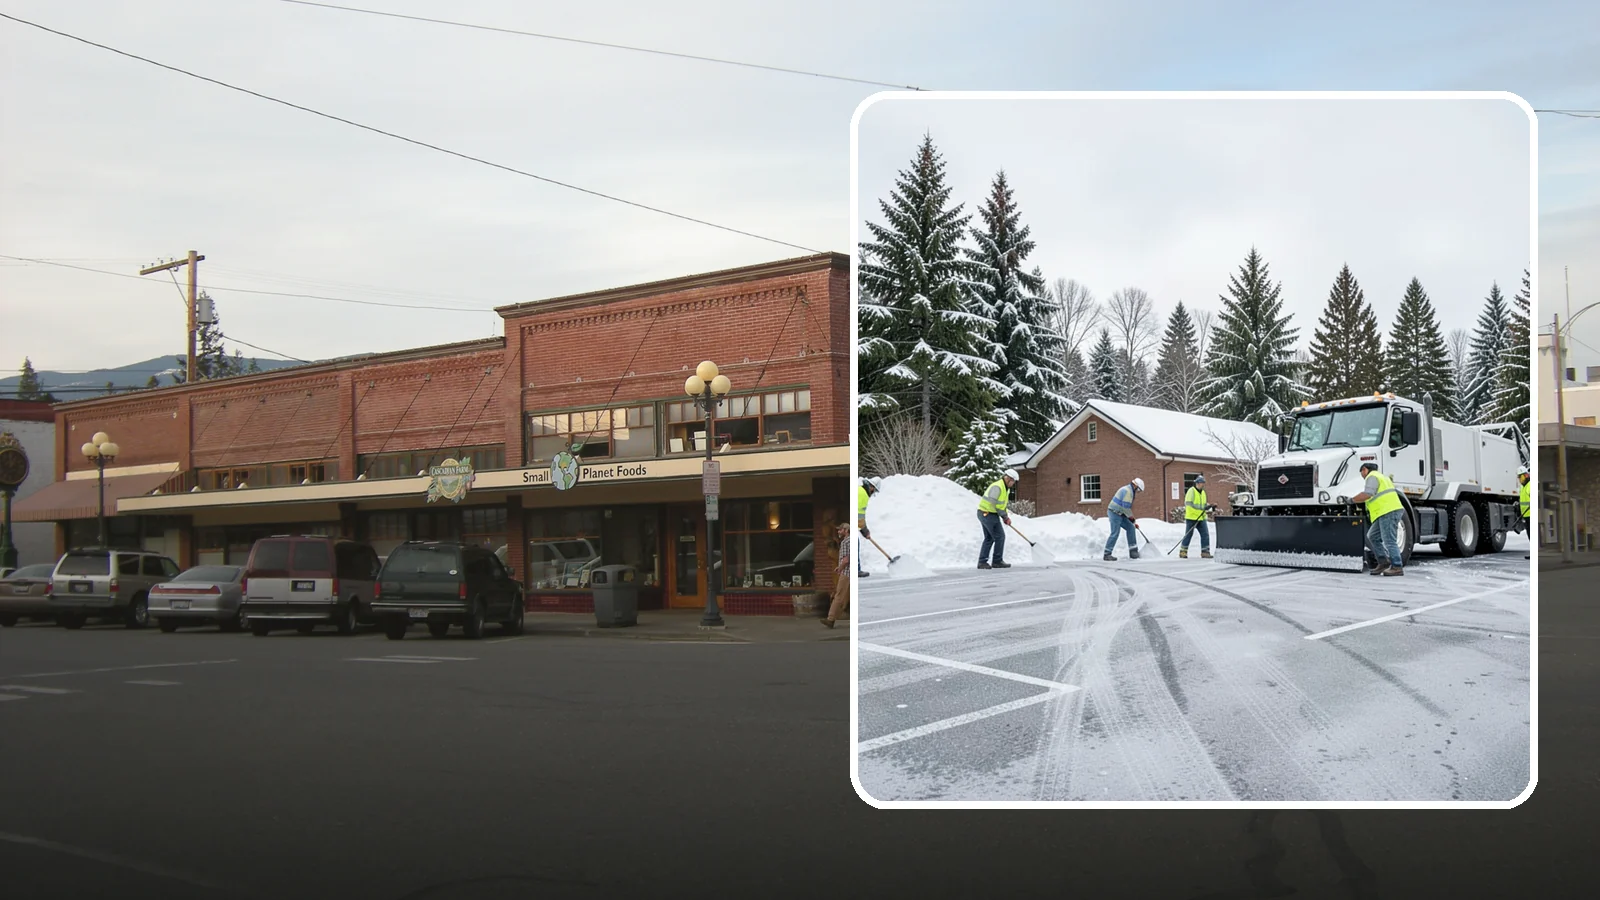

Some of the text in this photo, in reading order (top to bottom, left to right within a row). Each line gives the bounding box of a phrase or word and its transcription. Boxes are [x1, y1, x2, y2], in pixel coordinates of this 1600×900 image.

[523, 464, 647, 483] Small Planet Foods
